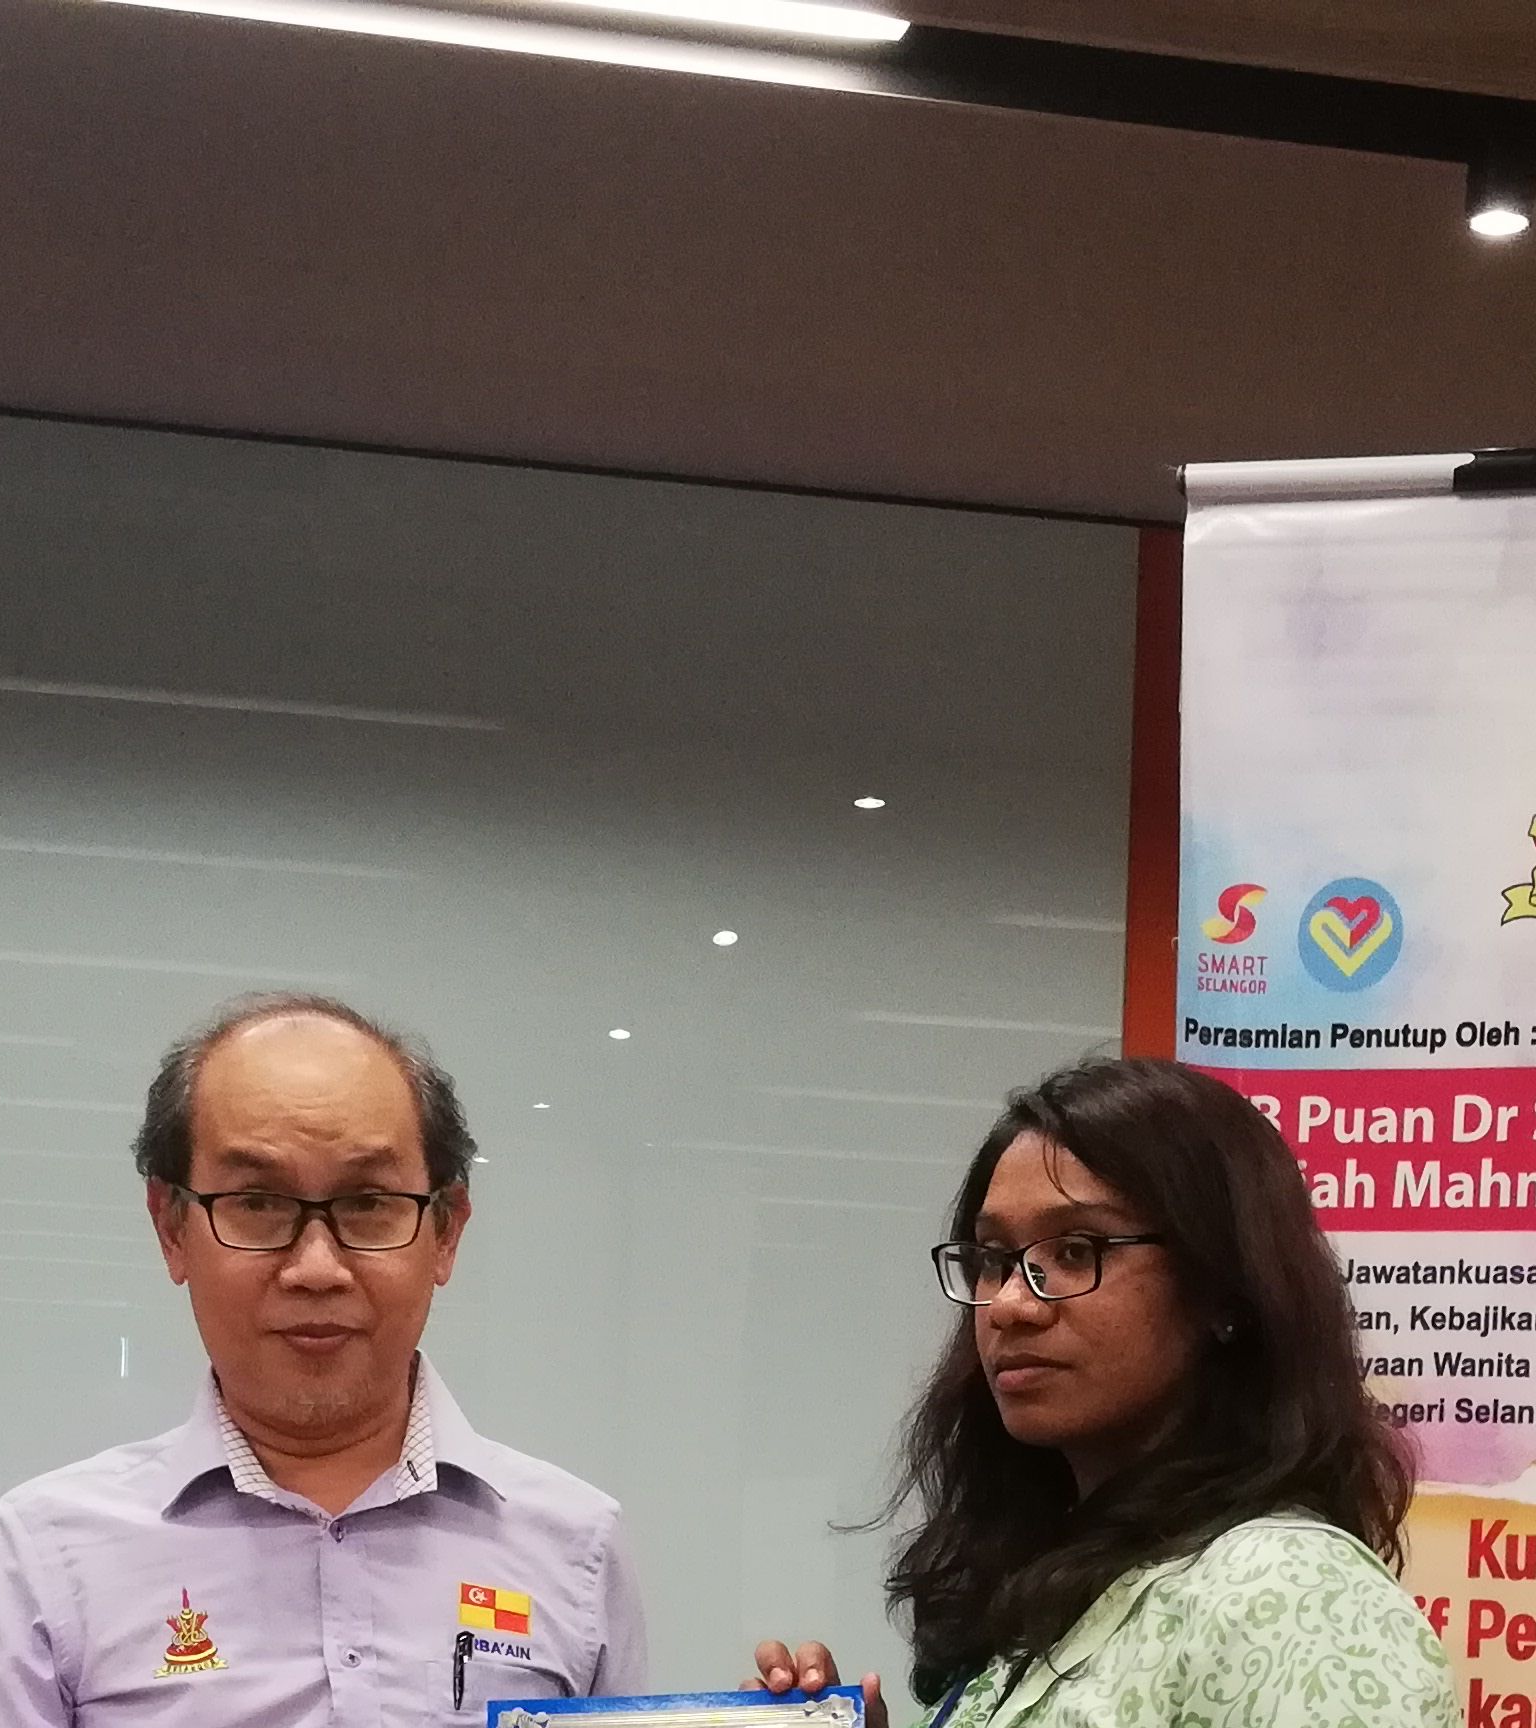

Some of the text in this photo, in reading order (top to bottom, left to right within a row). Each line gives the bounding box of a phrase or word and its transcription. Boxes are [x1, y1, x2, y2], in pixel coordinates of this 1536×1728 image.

[1197, 953, 1268, 976] SMART
[1196, 976, 1267, 995] SELANGOR
[1184, 1017, 1321, 1049] Perasmian
[1330, 1022, 1447, 1053] Penutup
[1455, 1021, 1520, 1048] Oleh
[1297, 1094, 1435, 1143] Puan
[1451, 1094, 1519, 1143] Dr
[1434, 1352, 1530, 1378] Wanita
